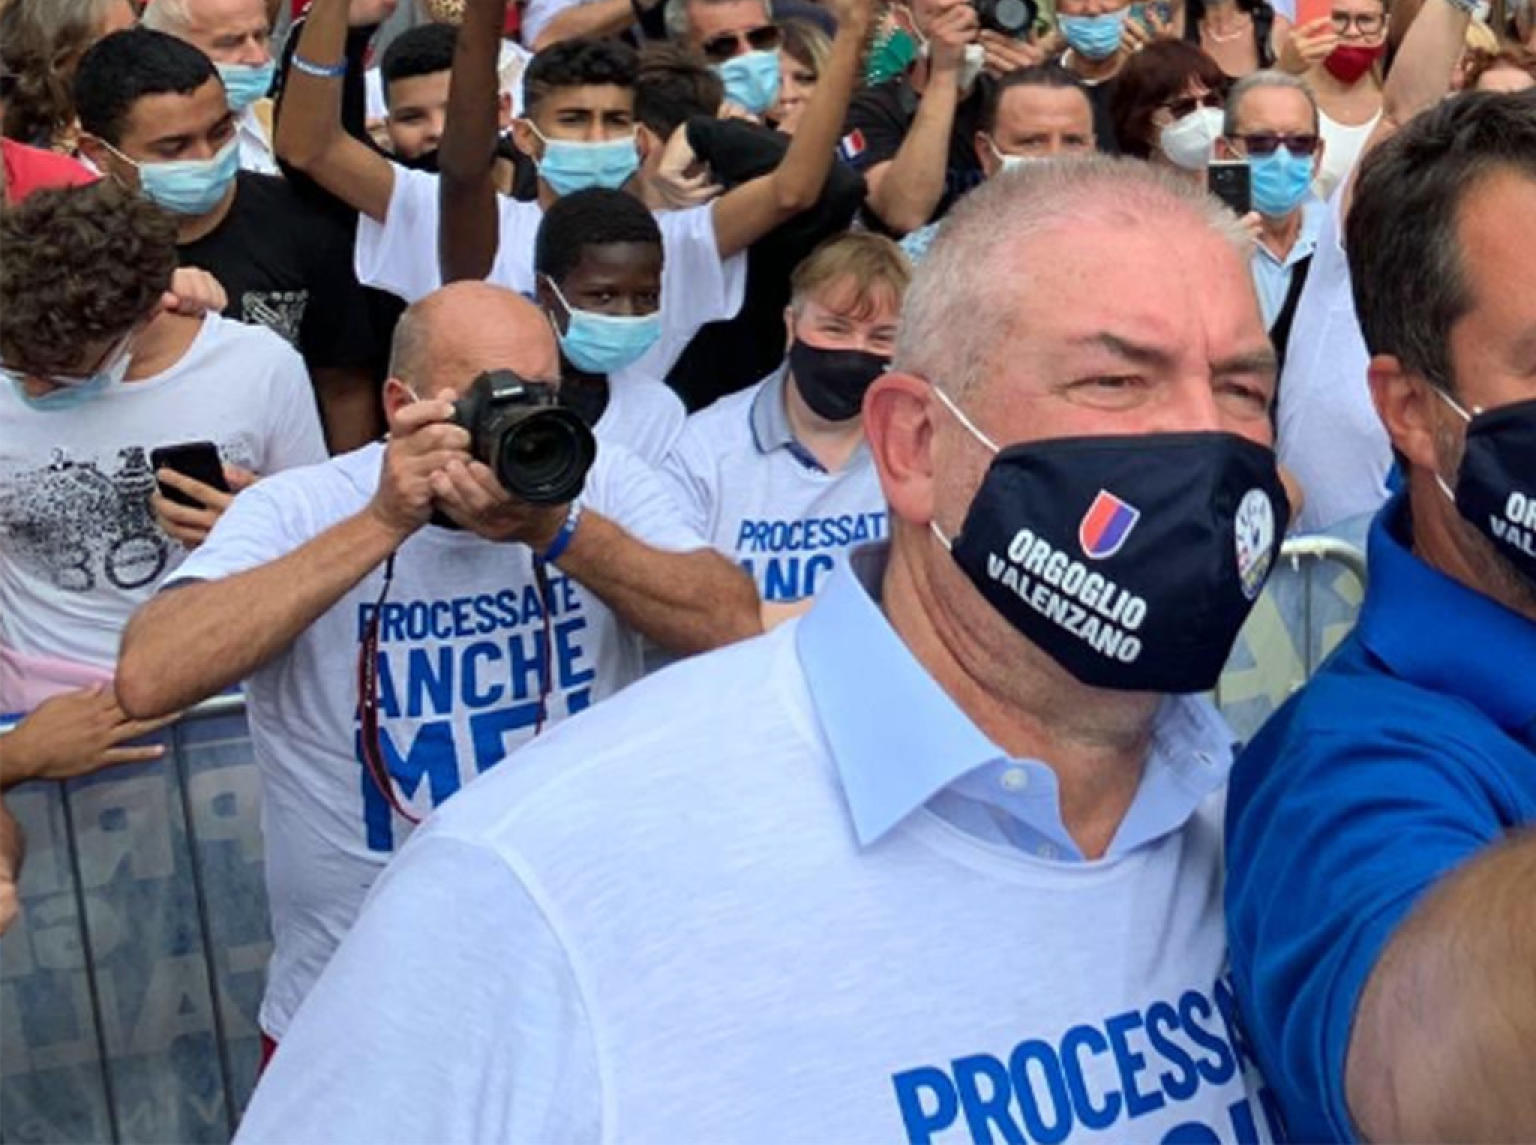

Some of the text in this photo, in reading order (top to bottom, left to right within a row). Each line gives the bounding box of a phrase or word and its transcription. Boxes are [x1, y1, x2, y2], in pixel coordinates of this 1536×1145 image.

[735, 511, 887, 553] PROCESSAT
[1008, 528, 1148, 631] ORGOGLIO
[358, 578, 583, 643] PROCESSATE
[987, 551, 1143, 664] VALENZANO
[892, 976, 1248, 1145] PROCESS
